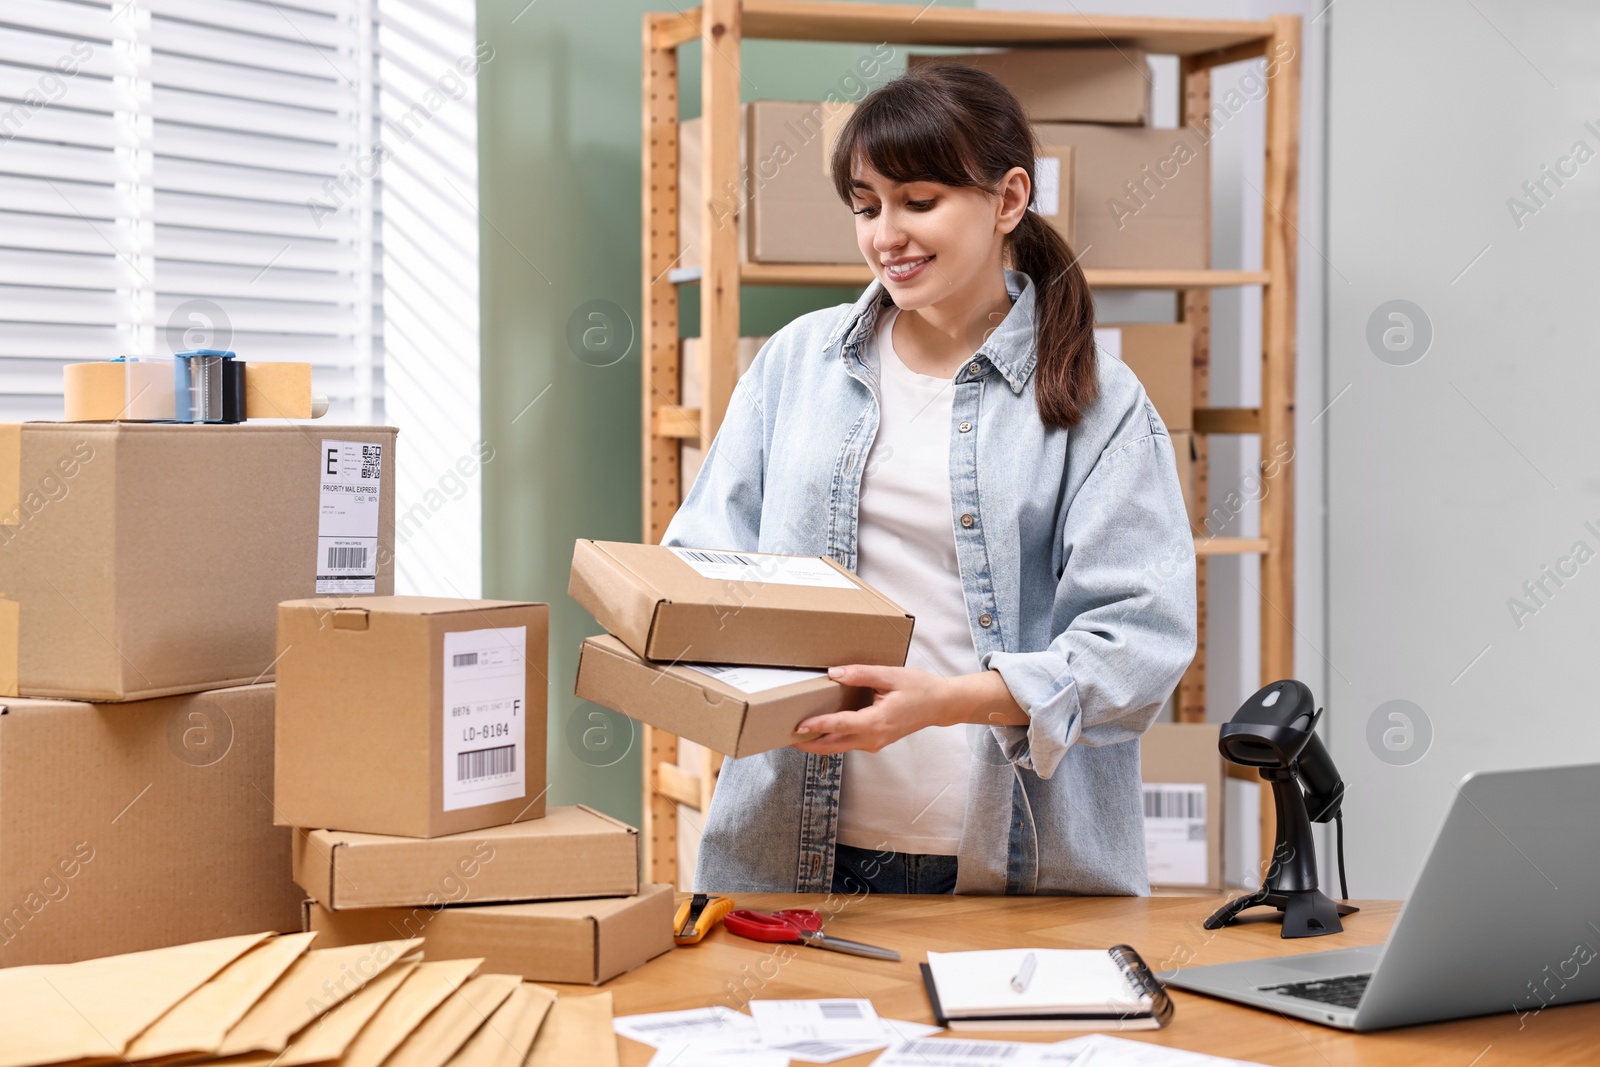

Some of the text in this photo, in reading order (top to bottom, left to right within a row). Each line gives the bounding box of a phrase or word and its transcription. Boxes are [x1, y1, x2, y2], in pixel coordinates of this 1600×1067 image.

[327, 448, 338, 475] E
[322, 484, 344, 493] PRIORITY
[356, 486, 377, 494] EXPRESS
[513, 699, 521, 716] F
[463, 722, 509, 742] LD-0104
